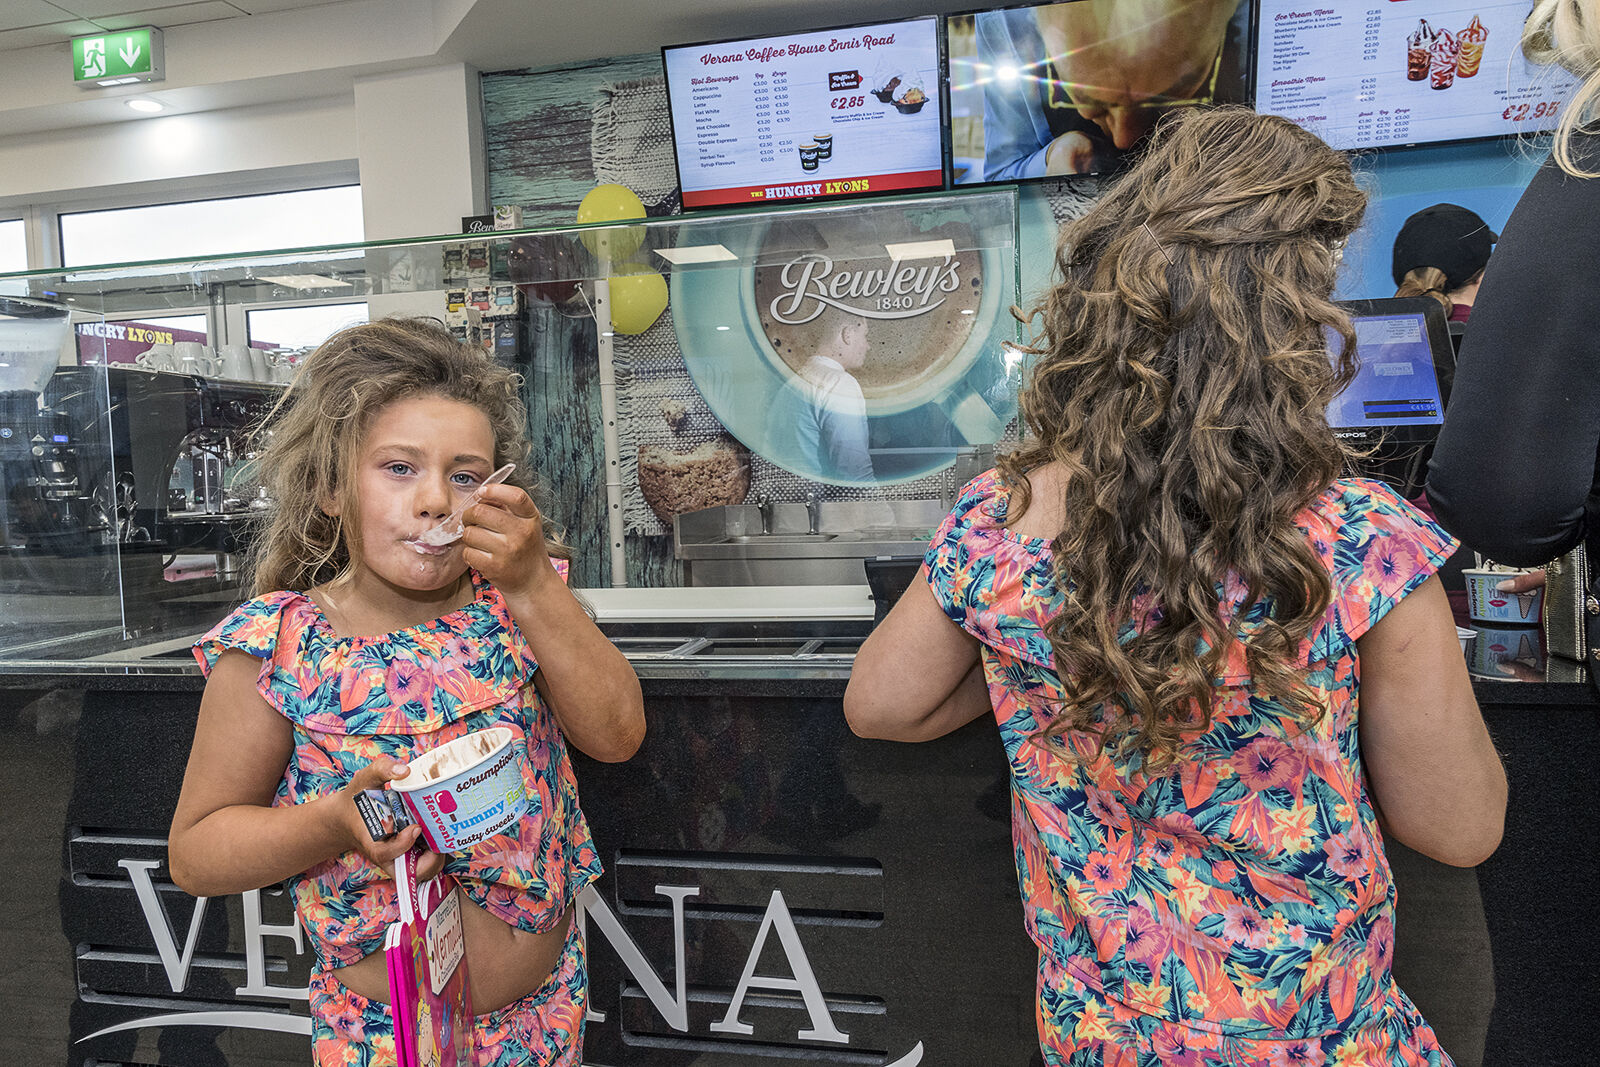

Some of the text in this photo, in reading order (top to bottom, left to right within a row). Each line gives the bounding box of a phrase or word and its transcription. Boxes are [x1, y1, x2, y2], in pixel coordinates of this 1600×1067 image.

[700, 34, 895, 65] Verona Coffee House Ennis Road
[705, 75, 739, 84] Beverages
[1272, 78, 1304, 87] Smoothie
[831, 96, 865, 110] €2.85
[1502, 101, 1561, 121] €2.95
[765, 184, 822, 198] HUNGRY
[826, 180, 869, 193] LYONS
[770, 254, 961, 325] Bewley's
[876, 296, 913, 310] 1840
[127, 327, 173, 344] LYONS
[1478, 578, 1486, 617] Heavenly
[422, 794, 456, 850] Heavenly
[449, 800, 505, 835] yummy
[457, 812, 516, 846] tasty sweets
[117, 858, 850, 1044] VENA
